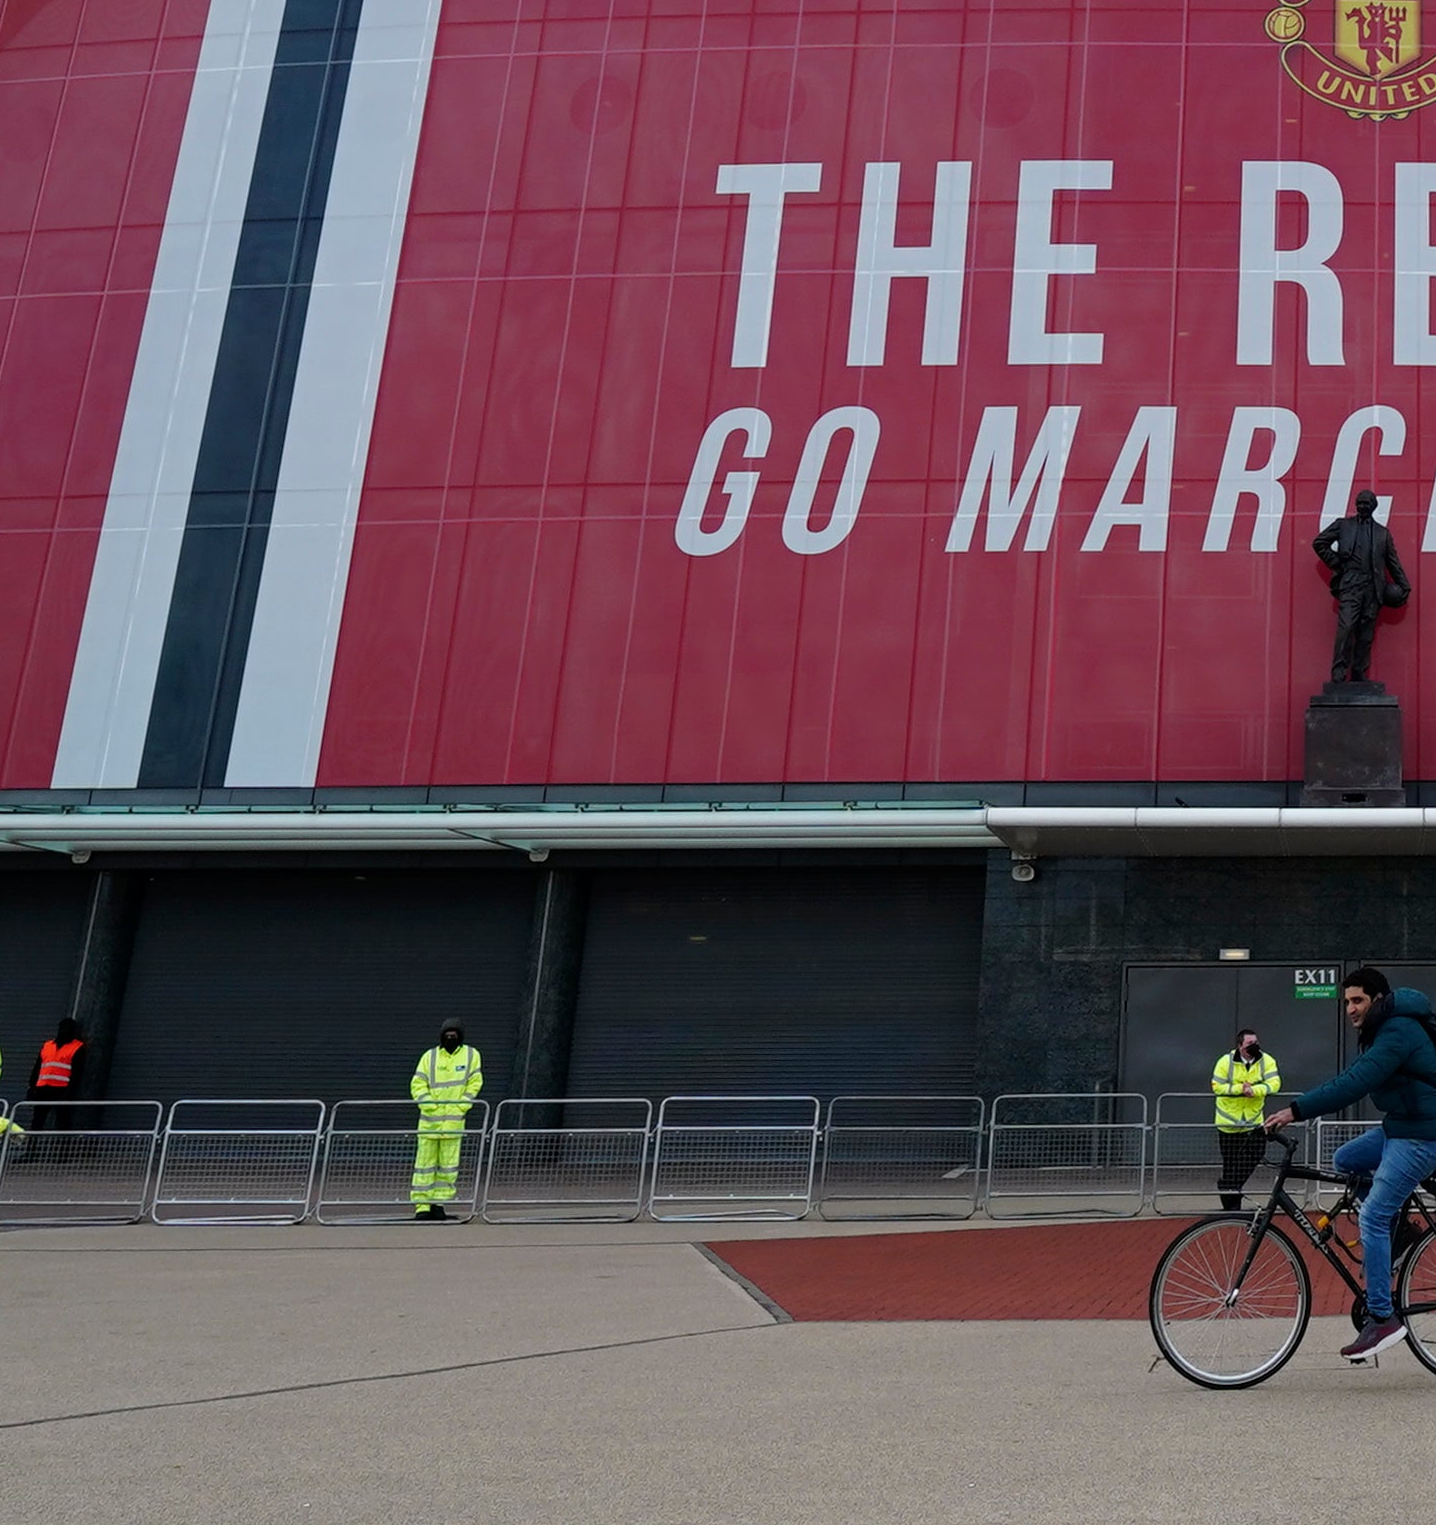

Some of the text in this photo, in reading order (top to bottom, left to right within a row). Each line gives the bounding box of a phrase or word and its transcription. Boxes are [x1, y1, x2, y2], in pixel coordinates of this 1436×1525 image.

[716, 160, 1113, 368] THE
[674, 406, 882, 557] GO
[1295, 969, 1335, 984] EX11
